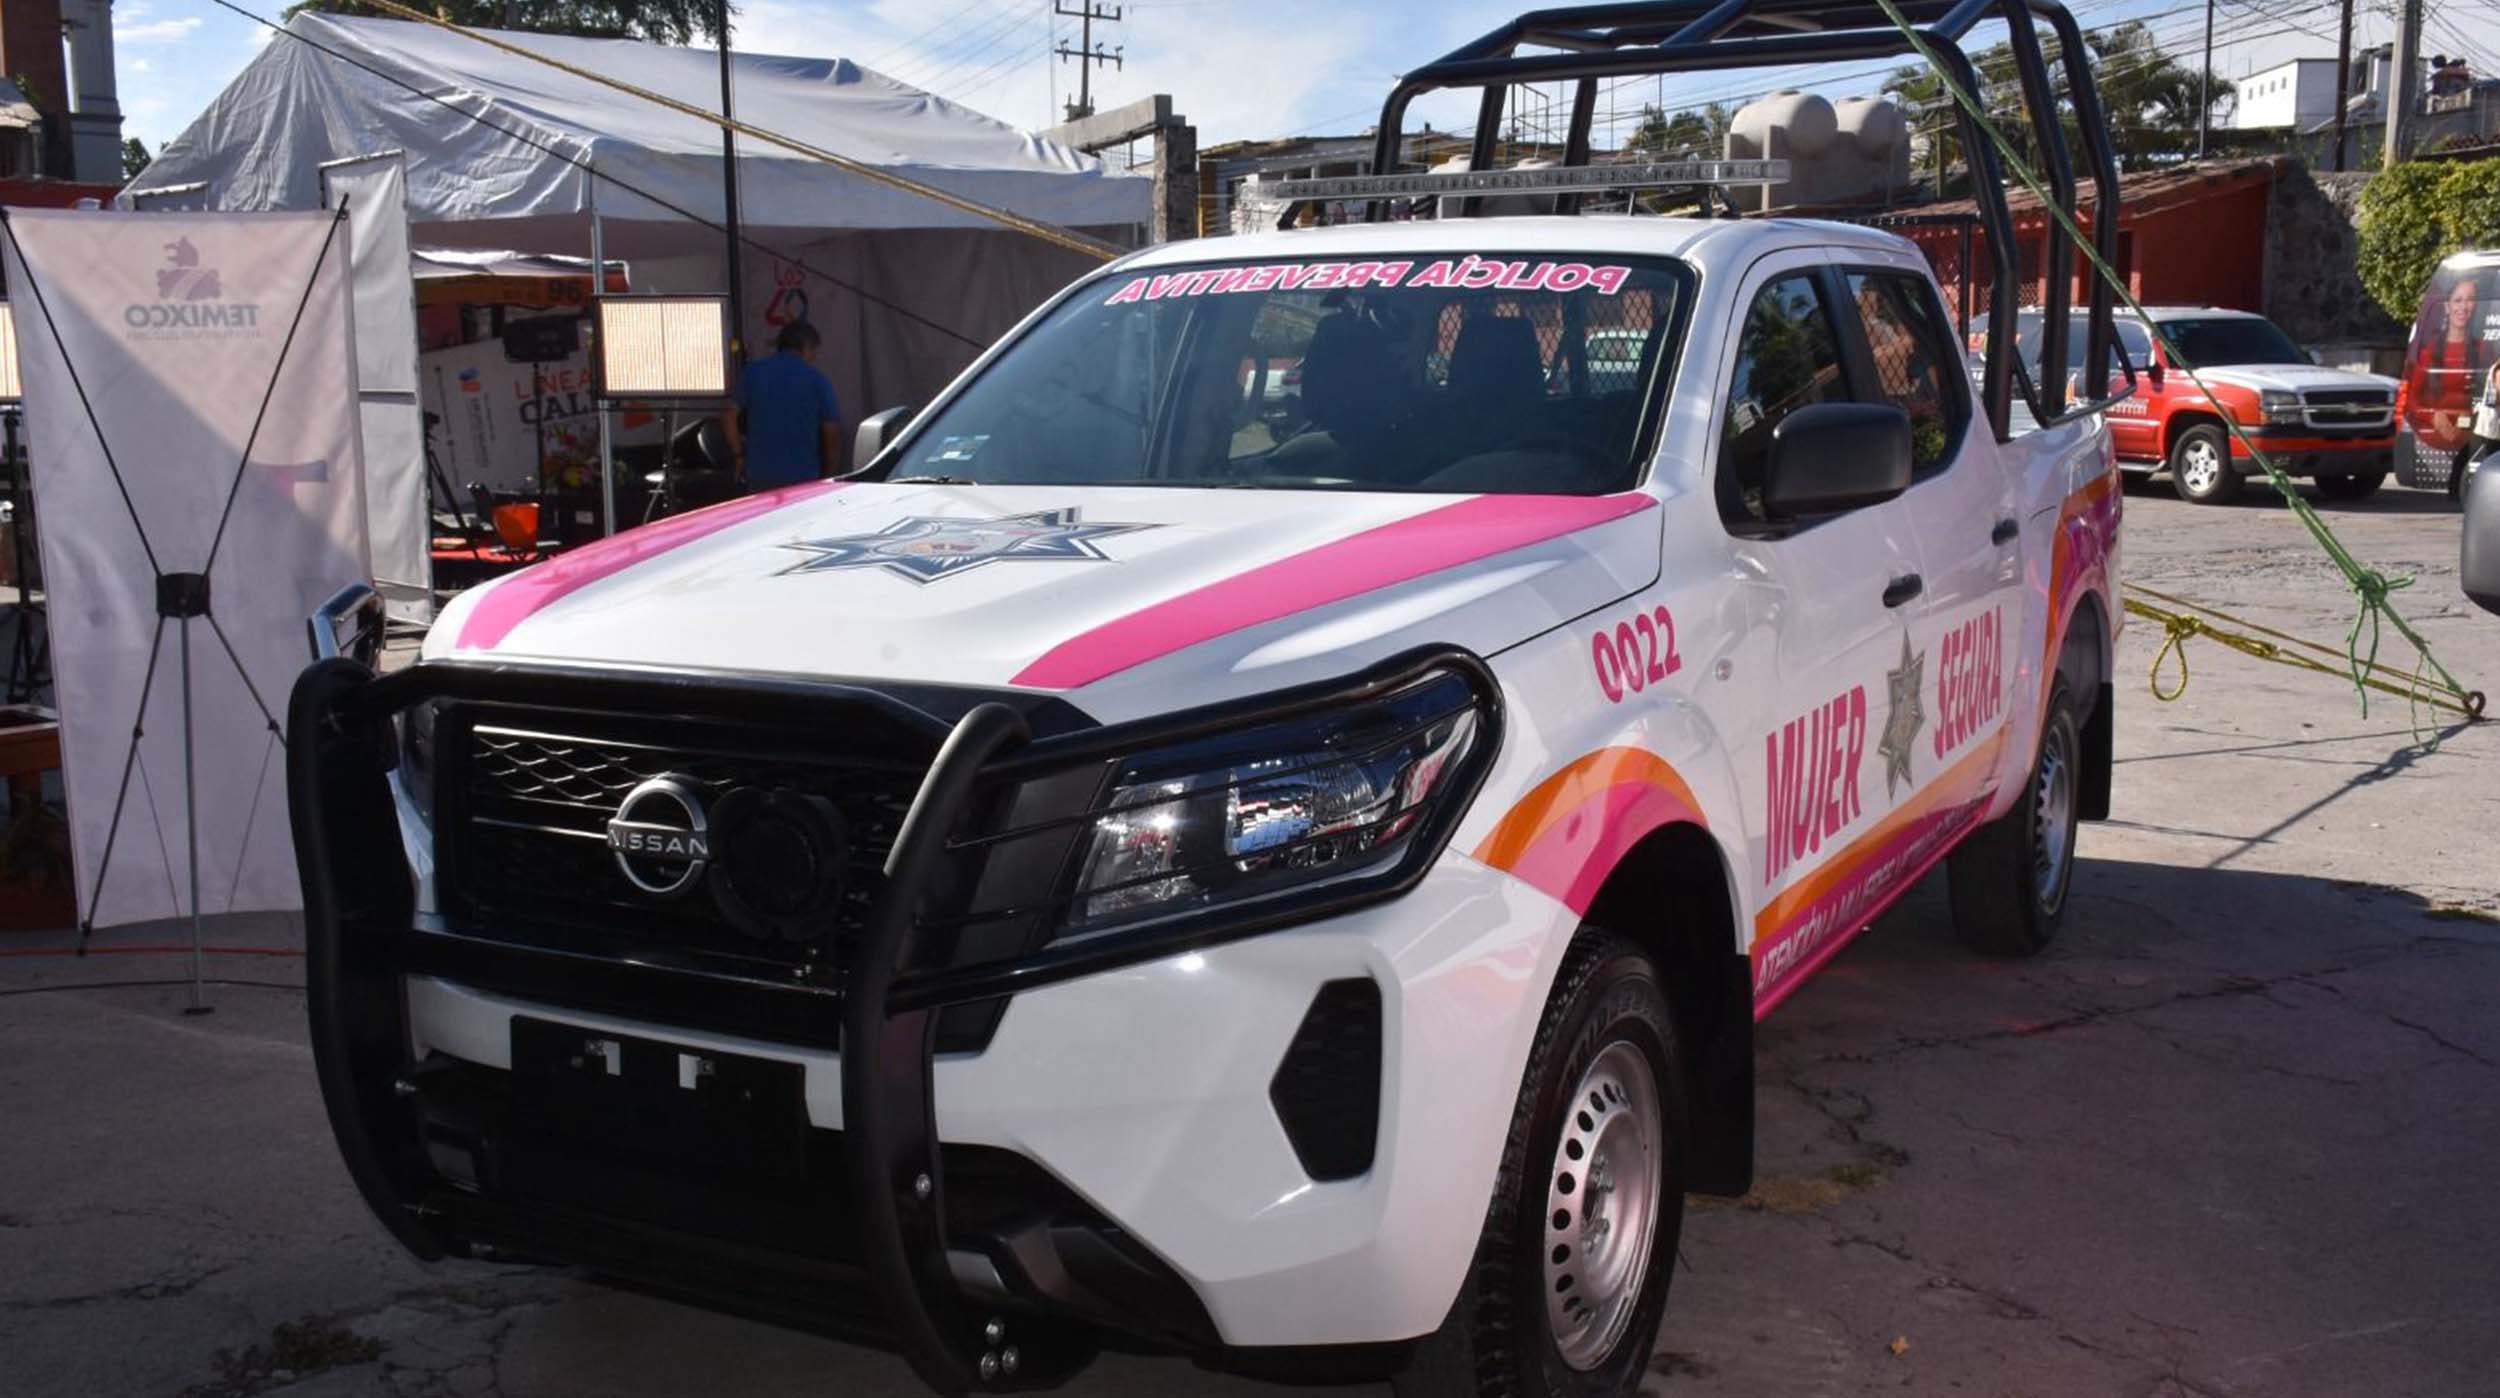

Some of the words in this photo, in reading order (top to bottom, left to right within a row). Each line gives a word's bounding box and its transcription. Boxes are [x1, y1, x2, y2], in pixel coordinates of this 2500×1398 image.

[1592, 605, 1681, 703] 0022
[1764, 684, 1867, 889] MUJER
[1934, 604, 2003, 762] SEGURA
[608, 829, 709, 855] NISSAN
